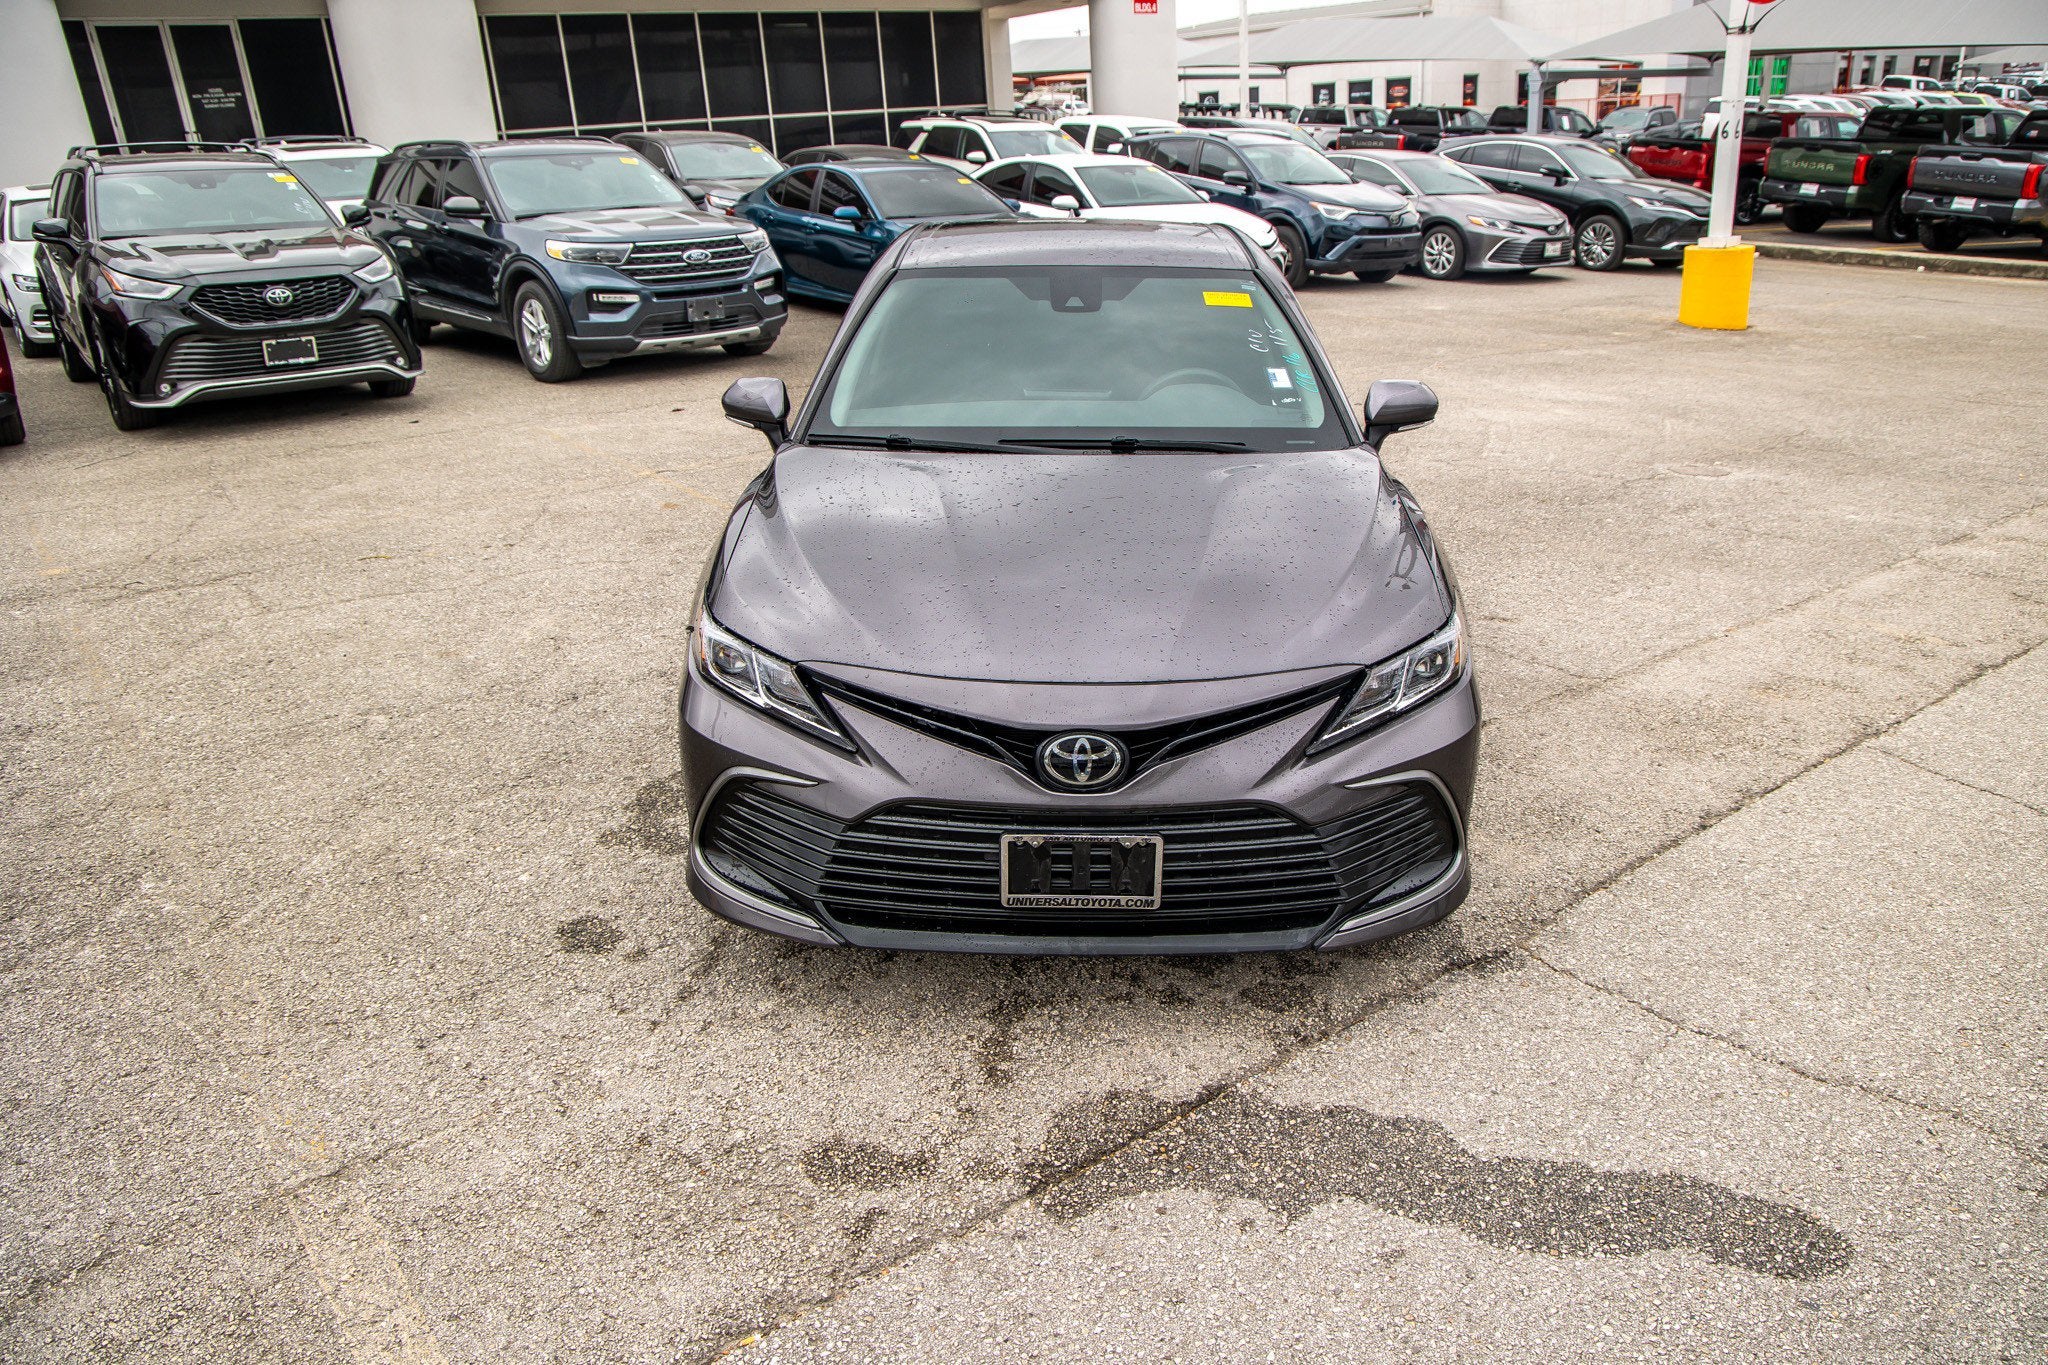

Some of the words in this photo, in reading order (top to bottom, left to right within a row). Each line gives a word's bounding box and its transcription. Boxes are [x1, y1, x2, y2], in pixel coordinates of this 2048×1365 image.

[1134, 2, 1157, 13] BLDG.4
[1721, 120, 1730, 139] 6
[1783, 159, 1836, 172] TUNDRA
[1934, 168, 1998, 184] TUNDRA
[1006, 897, 1155, 909] UNIVERSALTOYOTA.COM
